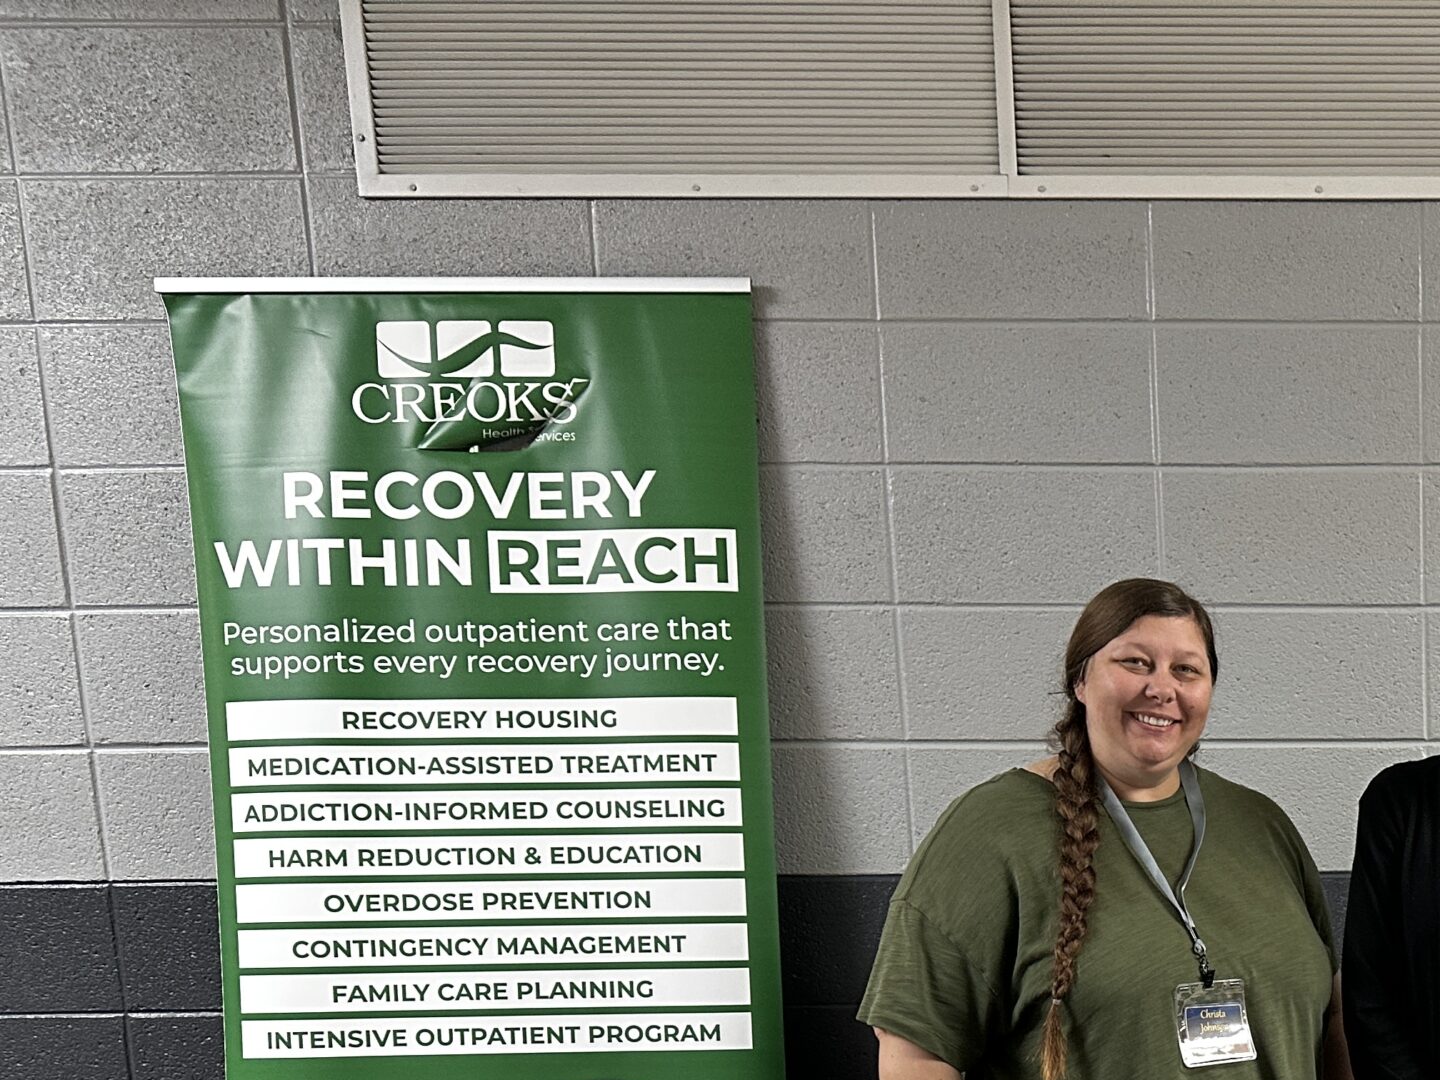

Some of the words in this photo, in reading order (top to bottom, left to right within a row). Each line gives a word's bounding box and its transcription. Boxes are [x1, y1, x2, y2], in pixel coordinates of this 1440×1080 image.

[352, 381, 577, 424] CREOKS
[529, 430, 576, 442] ervices
[283, 470, 656, 519] RECOVERY
[214, 538, 472, 589] WITHIN
[497, 537, 730, 586] REACH
[224, 619, 416, 645] Personalized
[425, 618, 589, 648] outpatient
[597, 622, 659, 641] care
[667, 616, 732, 640] that
[231, 652, 364, 679] supports
[373, 655, 457, 679] every
[467, 654, 598, 678] recovery
[603, 648, 725, 677] journey.
[342, 710, 487, 730] RECOVERY
[496, 709, 617, 729] HOUSING
[248, 755, 554, 777] MEDICATION-ASSISTED
[561, 754, 718, 774] TREATMENT
[244, 801, 549, 823] ADDICTION-INFORMED
[556, 799, 726, 819] COUNSELING
[269, 849, 348, 868] HARM
[358, 847, 516, 867] REDUCTION
[524, 847, 541, 865] &
[550, 845, 702, 865] EDUCATION
[323, 893, 474, 913] OVERDOSE
[483, 890, 651, 911] PREVENTION
[292, 937, 489, 958] CONTINGENCY
[497, 935, 687, 955] MANAGEMENT
[332, 984, 430, 1003] FAMILY
[437, 982, 508, 1002] CARE
[517, 980, 654, 1000] PLANNING
[267, 1029, 408, 1049] INTENSIVE
[415, 1026, 581, 1046] OUTPATIENT
[588, 1024, 722, 1044] PROGRAM
